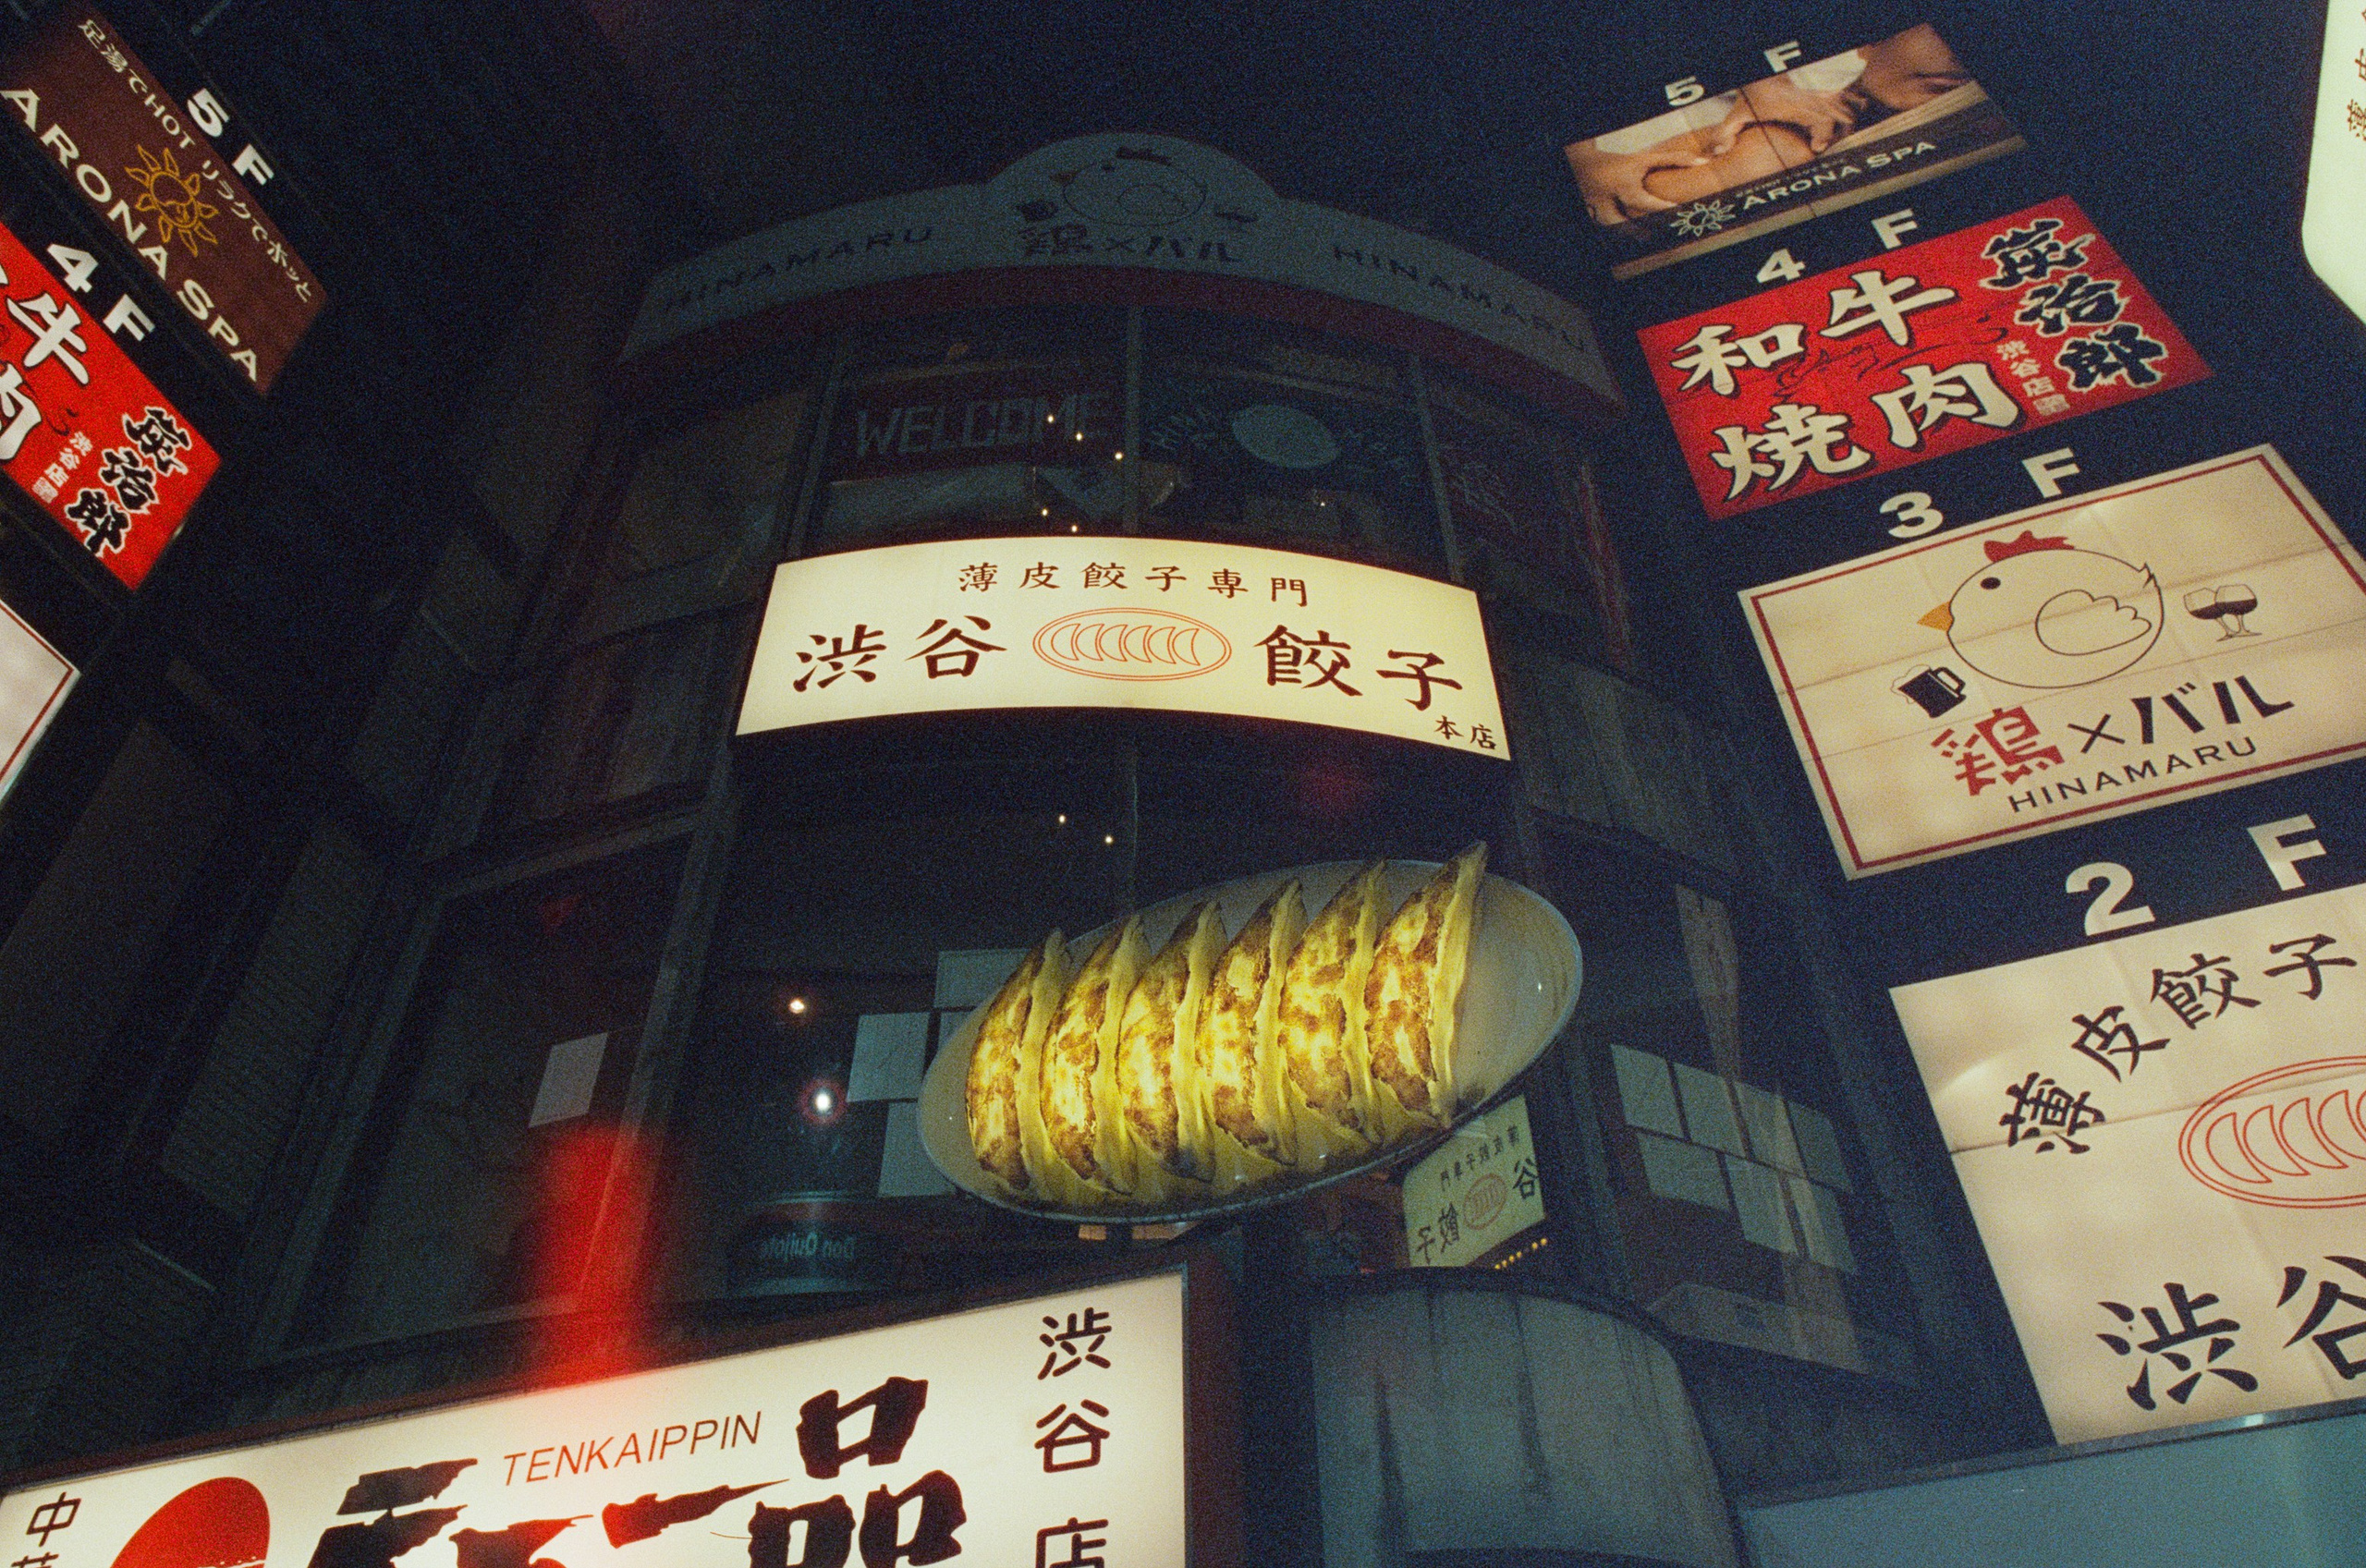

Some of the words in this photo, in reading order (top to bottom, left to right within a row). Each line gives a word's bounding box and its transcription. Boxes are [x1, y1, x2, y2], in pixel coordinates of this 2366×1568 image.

[1741, 164, 1867, 211] ARONA
[1866, 140, 1936, 170] SPA
[3, 88, 168, 281] ARONA
[177, 279, 263, 382] SPA
[1671, 269, 1957, 396] 和牛
[856, 392, 1109, 458] WELCOME
[1711, 361, 2020, 504] 焼肉
[957, 560, 1309, 606] 薄皮餃子専門
[792, 614, 1009, 692] 渋谷
[1252, 623, 1464, 711] 餃子
[1433, 714, 1497, 750] 本店
[2008, 735, 2257, 813] HINAMARU
[1999, 933, 2358, 1155] 薄皮餃子
[503, 1410, 762, 1487] TENKAIPPIN
[10, 1491, 82, 1568] 中
